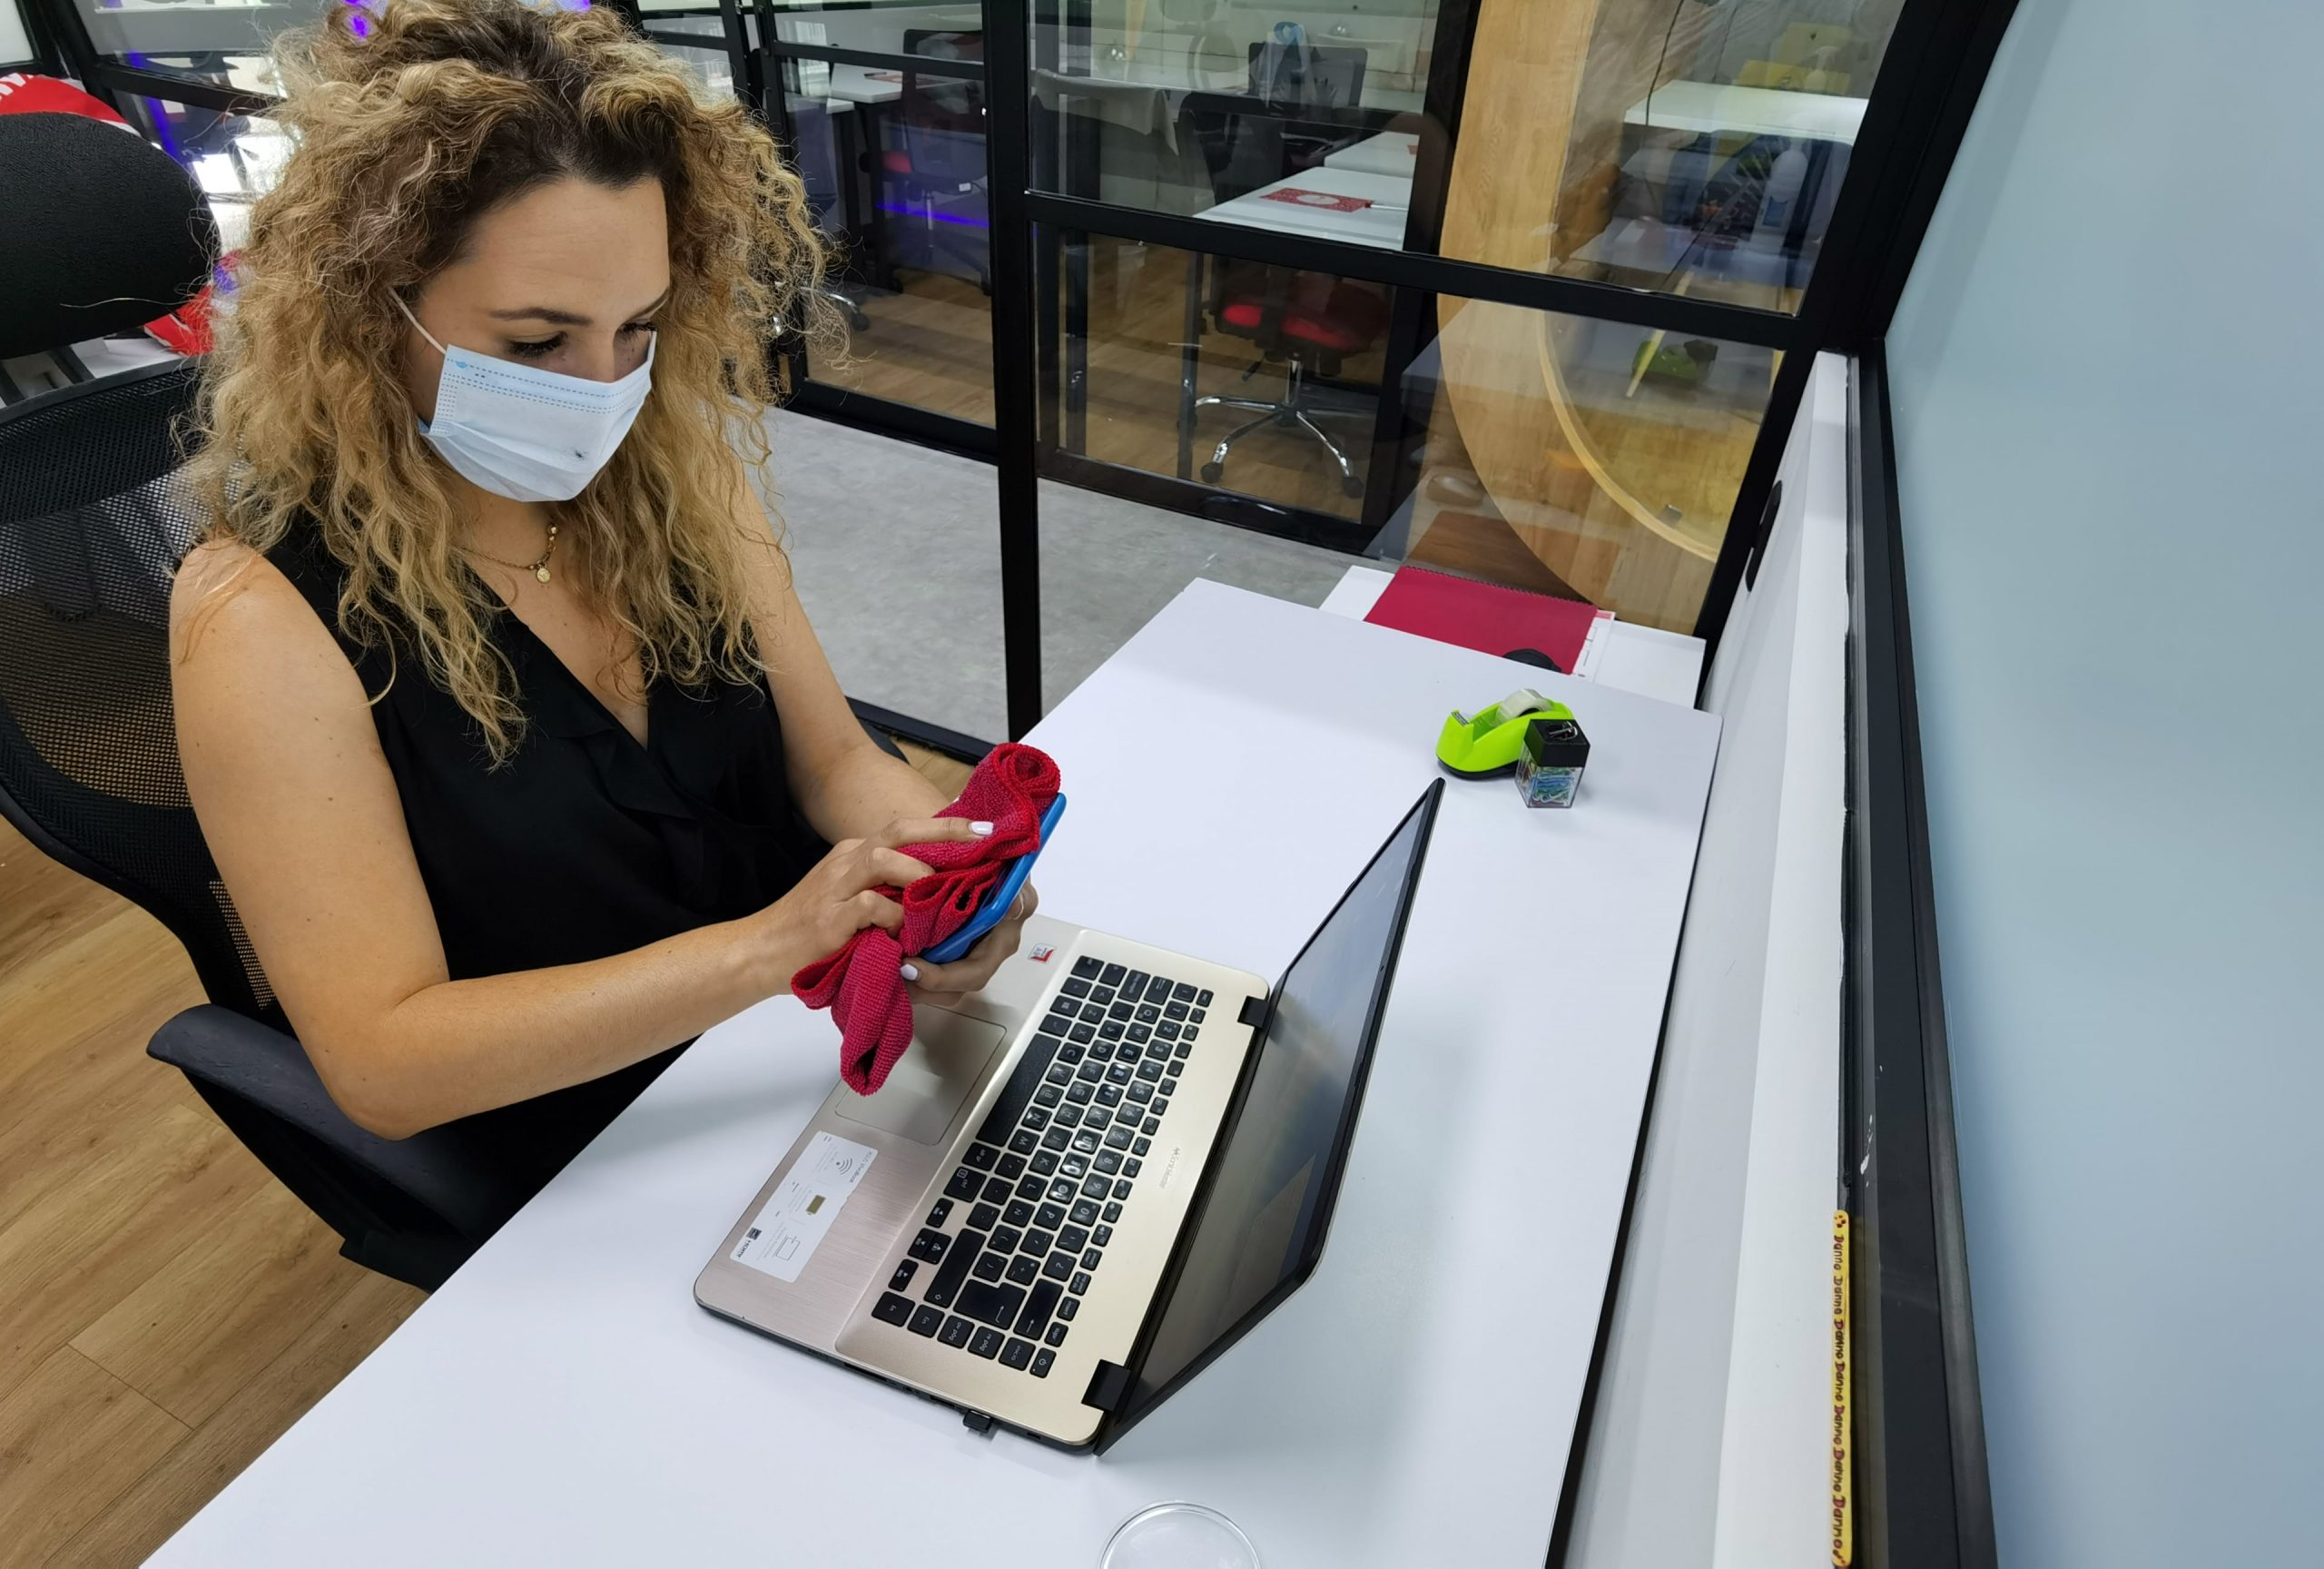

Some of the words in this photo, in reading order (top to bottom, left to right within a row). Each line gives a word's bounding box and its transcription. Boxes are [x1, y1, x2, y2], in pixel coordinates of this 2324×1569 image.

[1143, 1008, 1152, 1016] Q
[1133, 1027, 1144, 1036] W
[1075, 1088, 1085, 1096] G
[1031, 1113, 1041, 1121] N
[1064, 1110, 1073, 1119] H
[1018, 1136, 1029, 1146] M
[1039, 1157, 1049, 1166] K
[1103, 1156, 1113, 1164] 8
[1026, 1182, 1036, 1190] L
[1057, 1183, 1068, 1194] O
[1091, 1181, 1102, 1189] 9
[1044, 1210, 1054, 1219] P
[1078, 1207, 1089, 1215] 0
[1835, 1361, 1846, 1401] Danno
[1834, 1405, 1845, 1445] Danno
[1833, 1496, 1846, 1548] Danno
